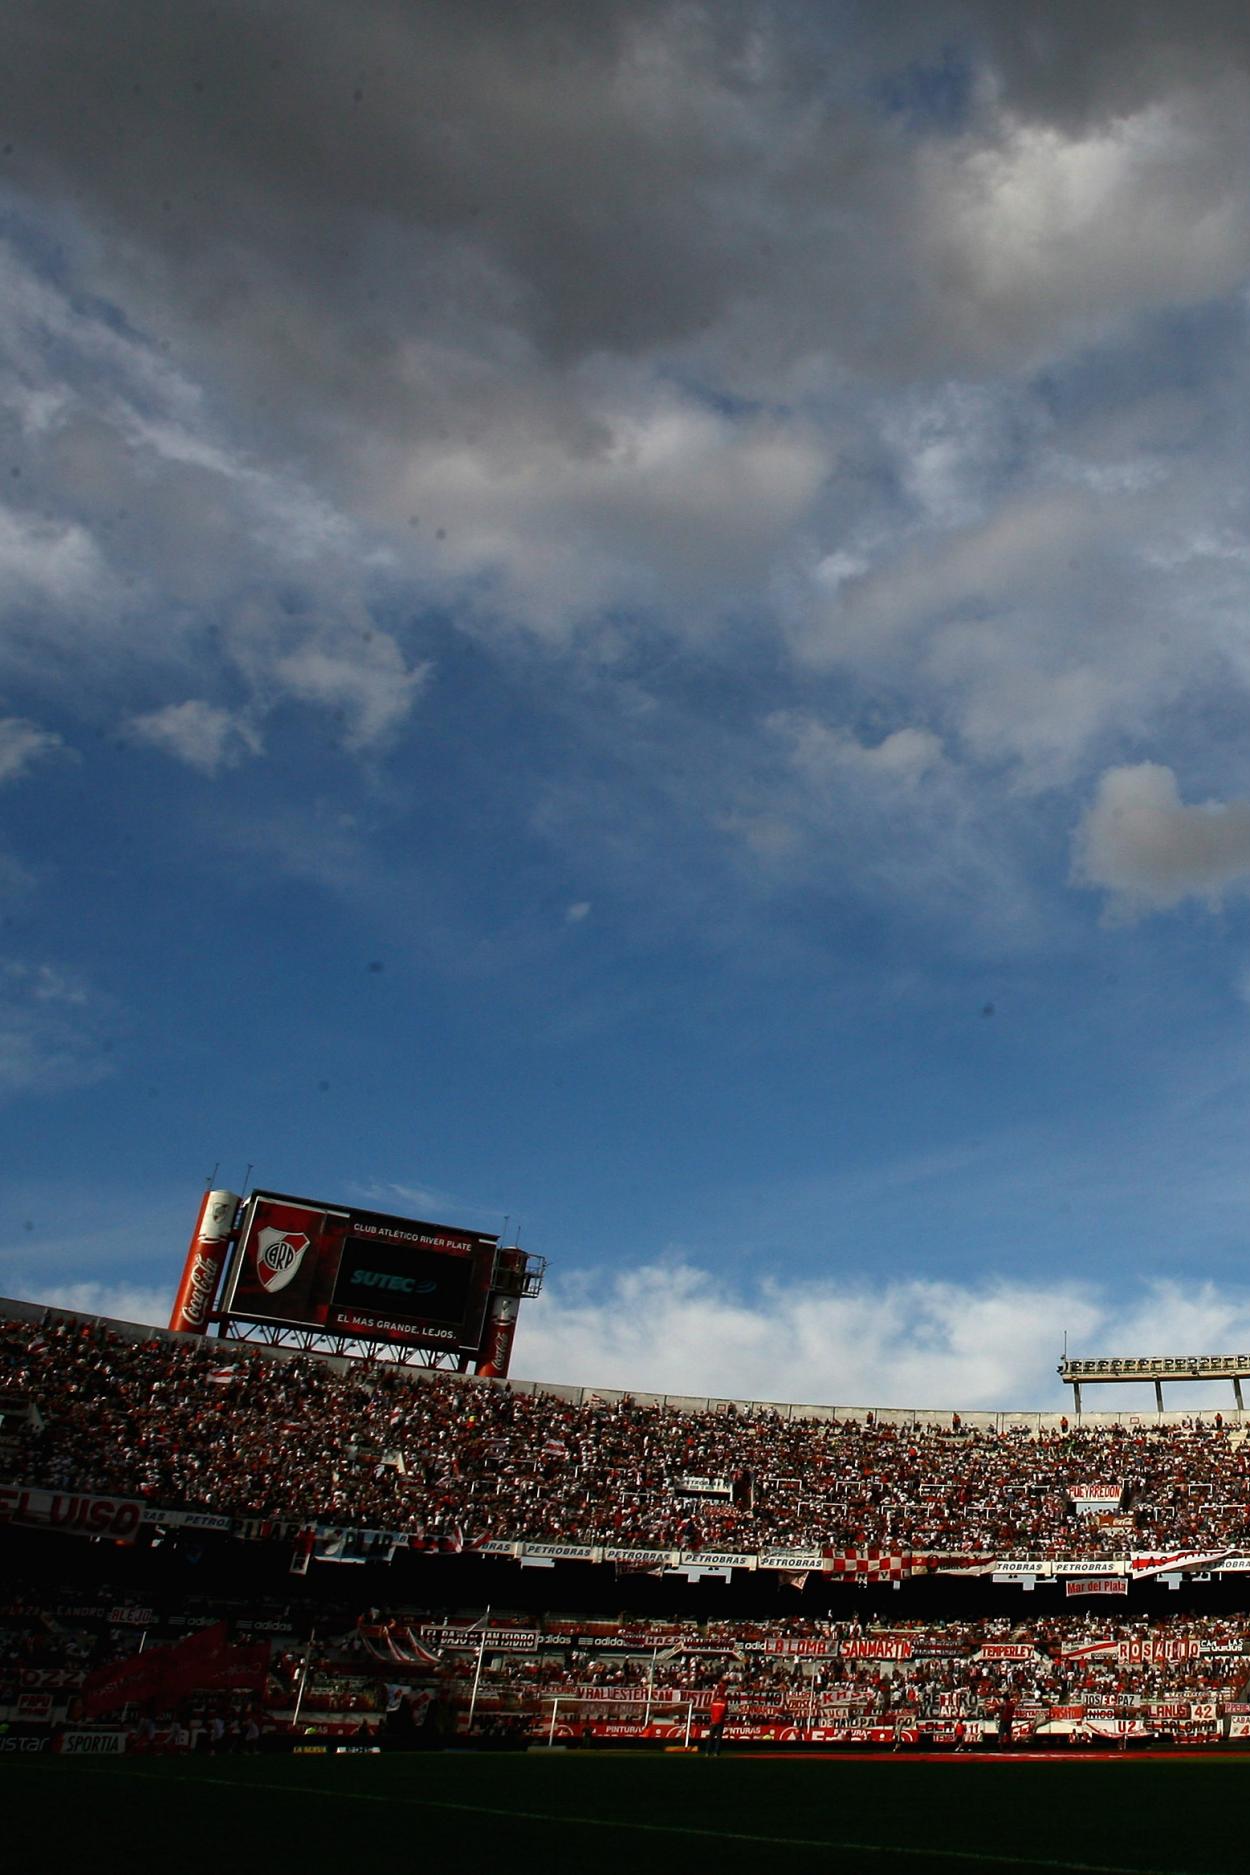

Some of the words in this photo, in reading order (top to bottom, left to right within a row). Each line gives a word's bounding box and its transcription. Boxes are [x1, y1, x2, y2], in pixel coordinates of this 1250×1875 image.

[354, 1223, 377, 1233] CLUB
[420, 1235, 445, 1247] RIVER
[447, 1240, 473, 1251] PLATE
[350, 1269, 416, 1293] SUTEC
[337, 1313, 349, 1323] EL
[352, 1316, 375, 1327] MAS
[185, 1514, 226, 1526] PETRO
[527, 1544, 592, 1558] PETROBRAS
[607, 1551, 671, 1564] PETROBRAS
[685, 1554, 747, 1567] PETROBRAS
[761, 1557, 822, 1570] PETROBRAS
[995, 1562, 1043, 1572] TROBRAS
[1056, 1562, 1114, 1572] PETROBRAS
[1068, 1582, 1087, 1595] Mar
[1089, 1581, 1101, 1593] del
[1105, 1581, 1127, 1594] Plata
[254, 1621, 293, 1634] adidas
[594, 1637, 625, 1646] adida
[744, 1640, 766, 1650] adid
[766, 1640, 784, 1655] LA
[788, 1640, 826, 1656] LOMA
[983, 1645, 1034, 1657] TEMPERLEY
[1120, 1644, 1198, 1658] ROSAIO
[1118, 1696, 1134, 1706] PAZ
[1149, 1704, 1187, 1718] LANUS
[1195, 1705, 1213, 1719] 42
[67, 1735, 119, 1752] SPORTIA
